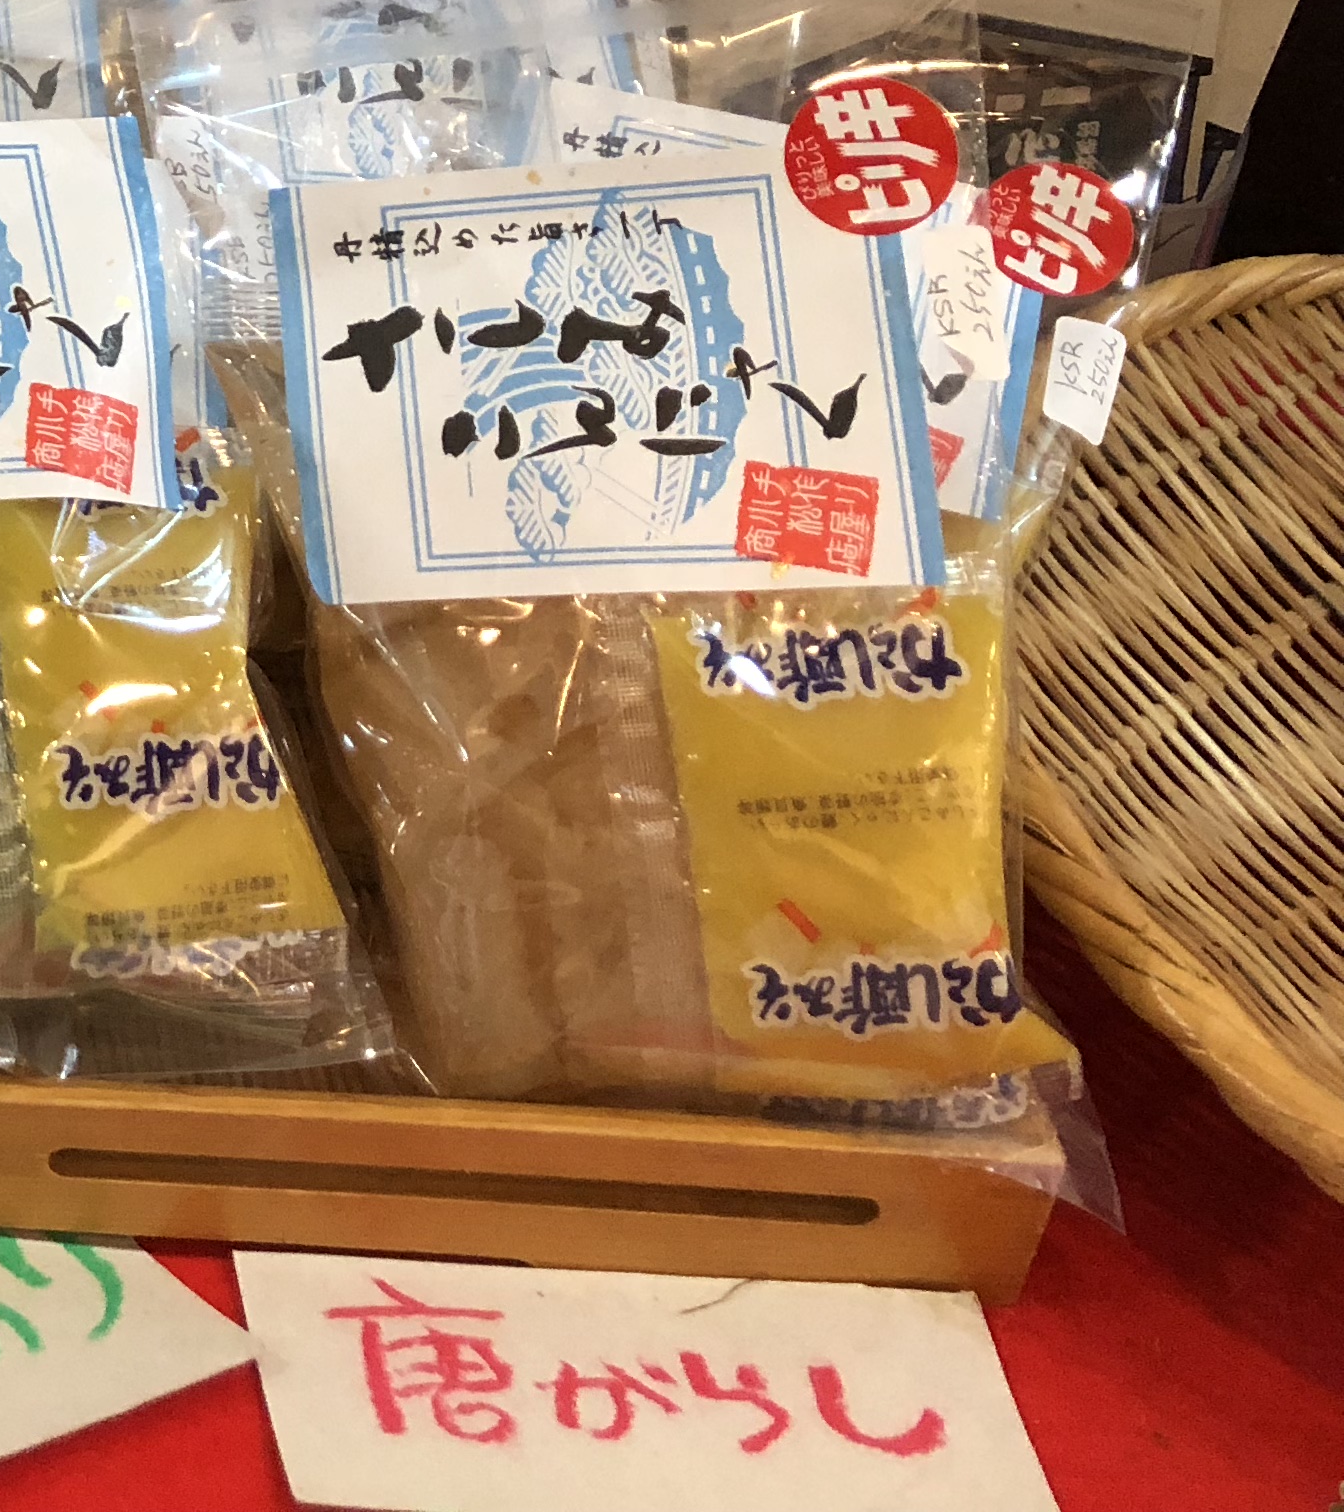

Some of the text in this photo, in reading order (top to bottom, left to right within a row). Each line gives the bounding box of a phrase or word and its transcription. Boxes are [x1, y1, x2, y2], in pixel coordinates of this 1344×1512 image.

[813, 86, 941, 226] ピリ辛
[333, 209, 685, 264] 丹精込めた旨さ一丁
[1002, 164, 1114, 295] ピリ辛
[323, 1276, 949, 1458] 唐がらし
